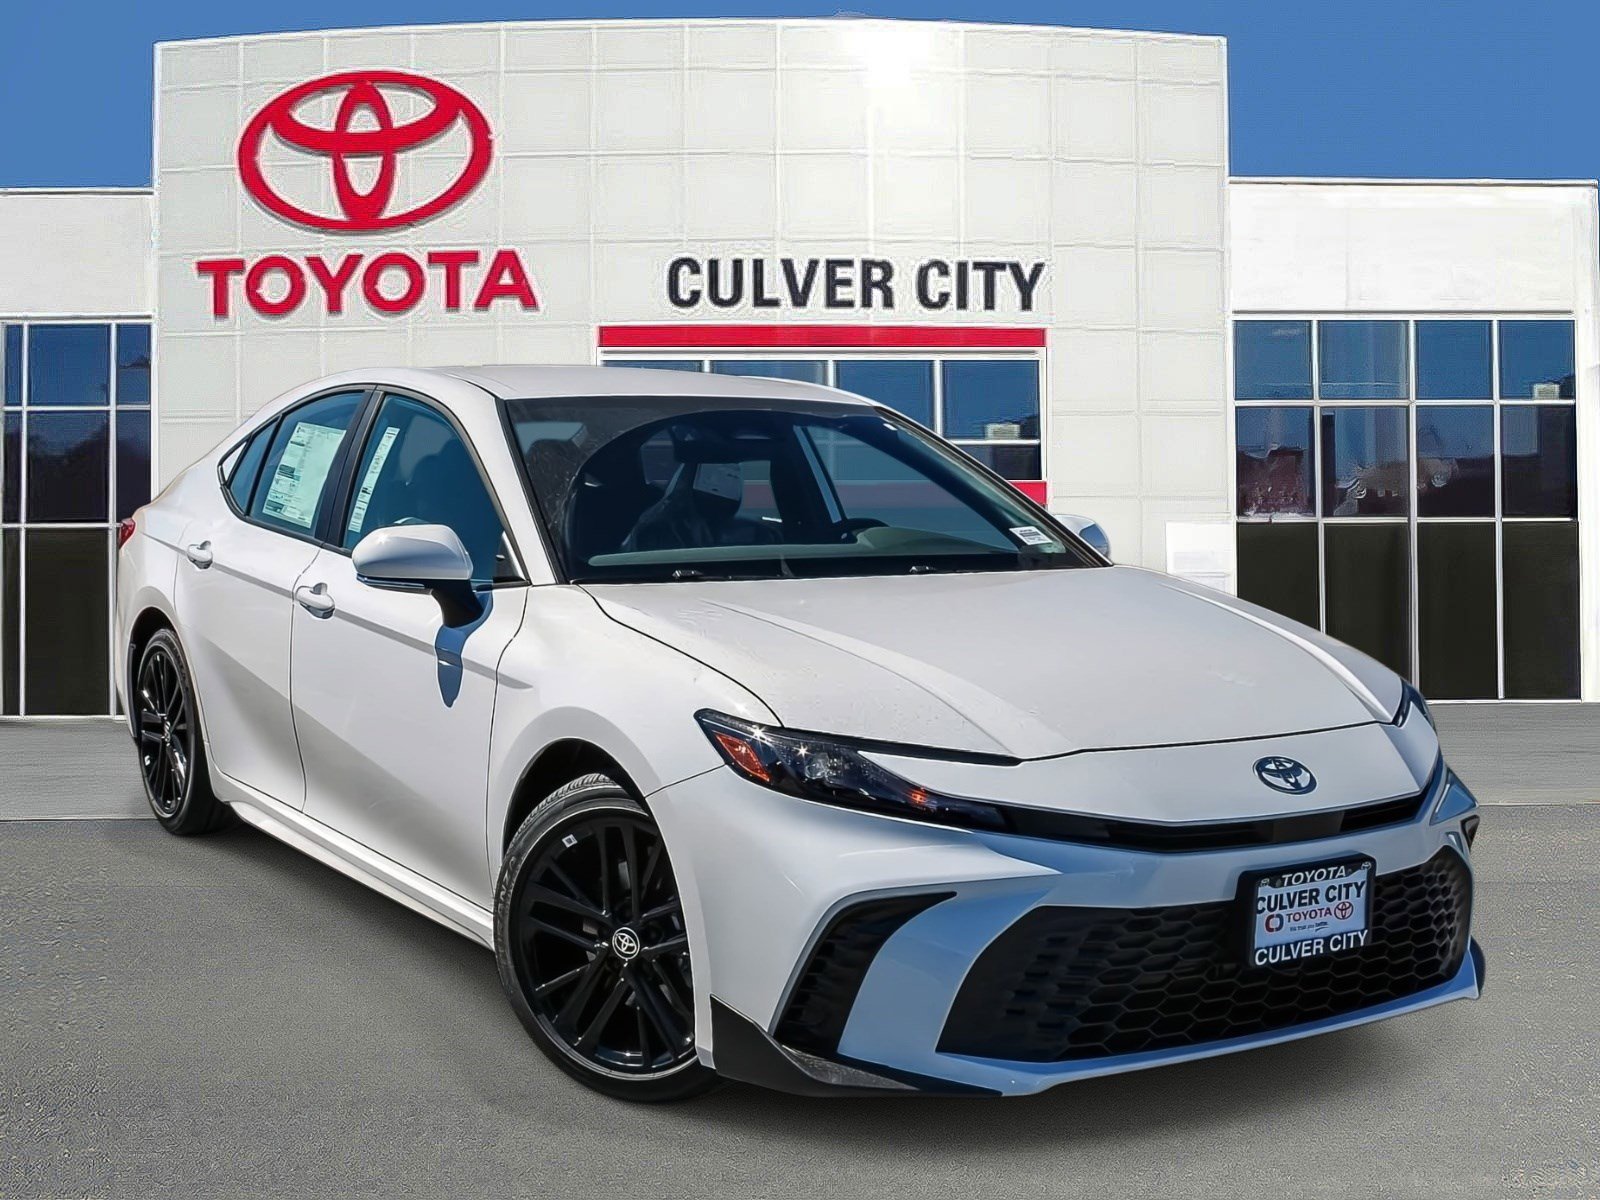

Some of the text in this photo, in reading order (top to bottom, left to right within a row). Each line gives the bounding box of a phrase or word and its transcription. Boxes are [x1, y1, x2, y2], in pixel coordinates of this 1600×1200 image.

[196, 249, 538, 318] TOYOTA
[668, 257, 1045, 311] CULVER CITY
[1282, 866, 1346, 887] TOYOTA
[1256, 881, 1366, 915] CULVER CITY
[1286, 907, 1332, 922] TOYOTA
[1255, 930, 1368, 966] CULVER CITY
